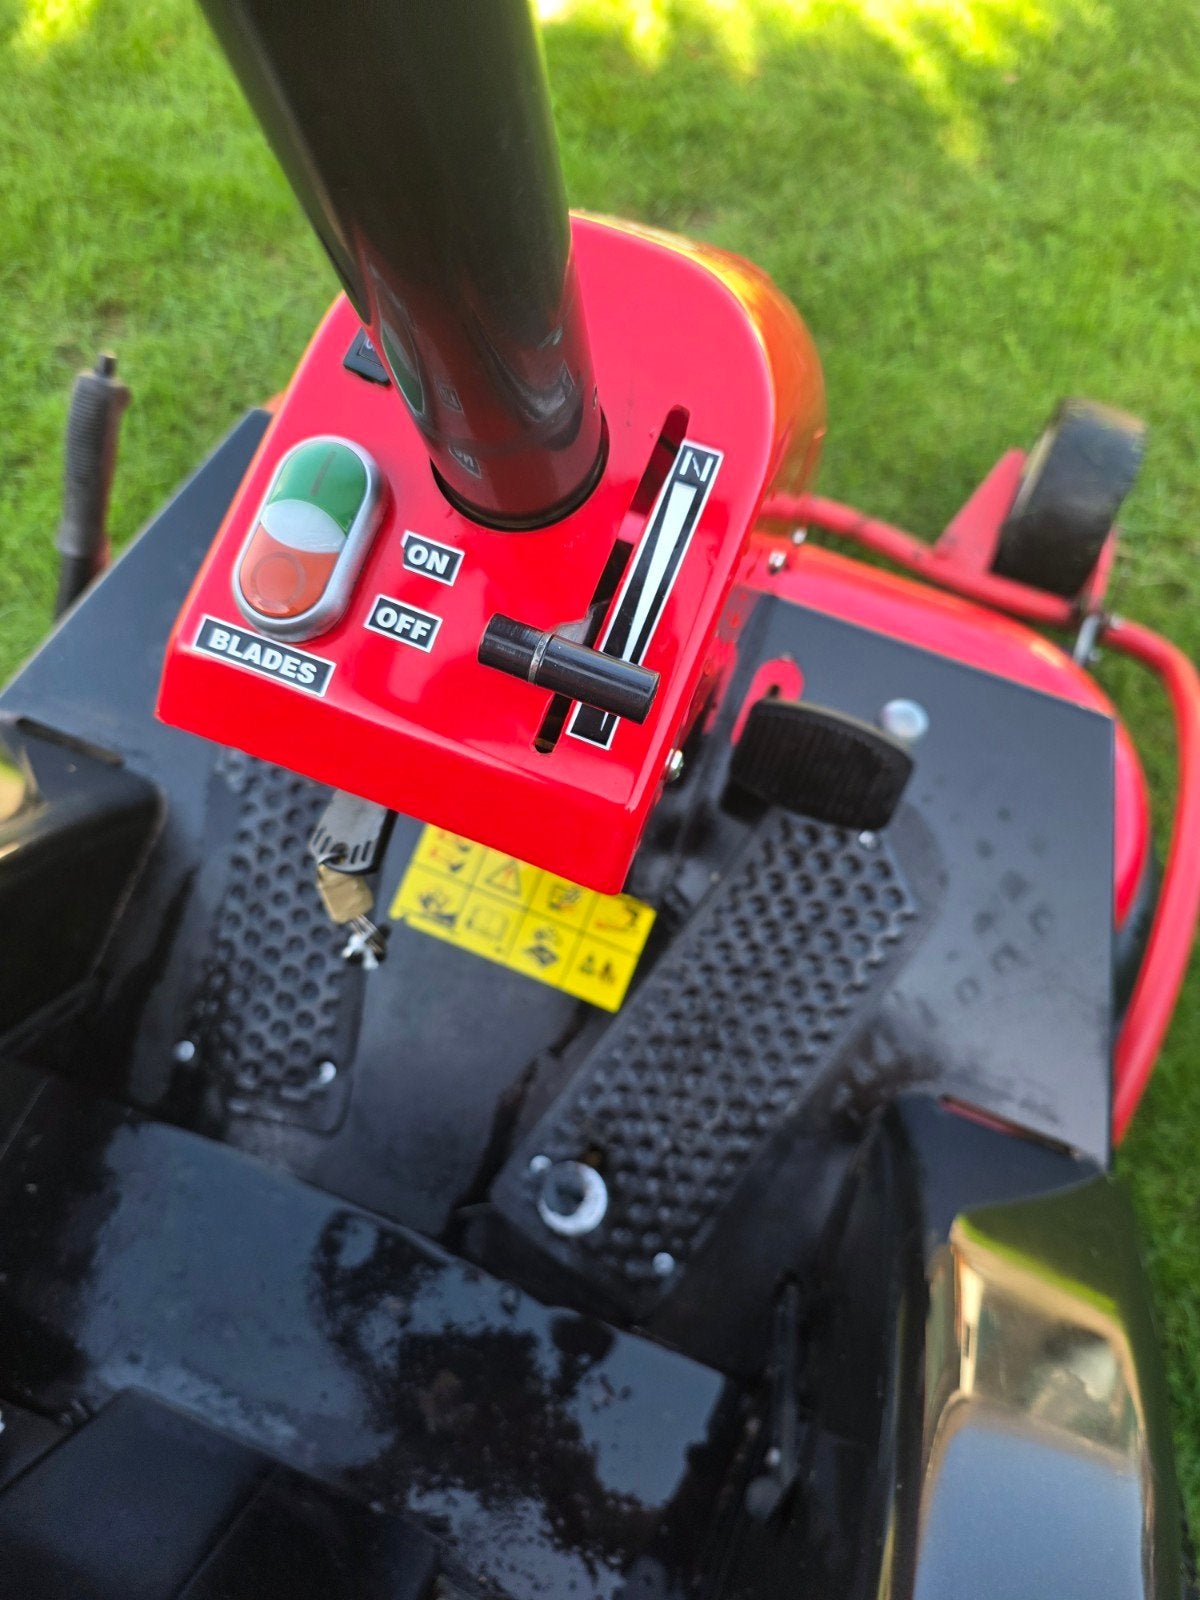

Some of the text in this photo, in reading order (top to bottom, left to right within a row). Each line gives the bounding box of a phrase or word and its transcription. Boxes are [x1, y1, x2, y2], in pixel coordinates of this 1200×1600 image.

[407, 545, 450, 575] ON
[376, 606, 432, 640] OFF
[208, 628, 317, 684] BLADES
